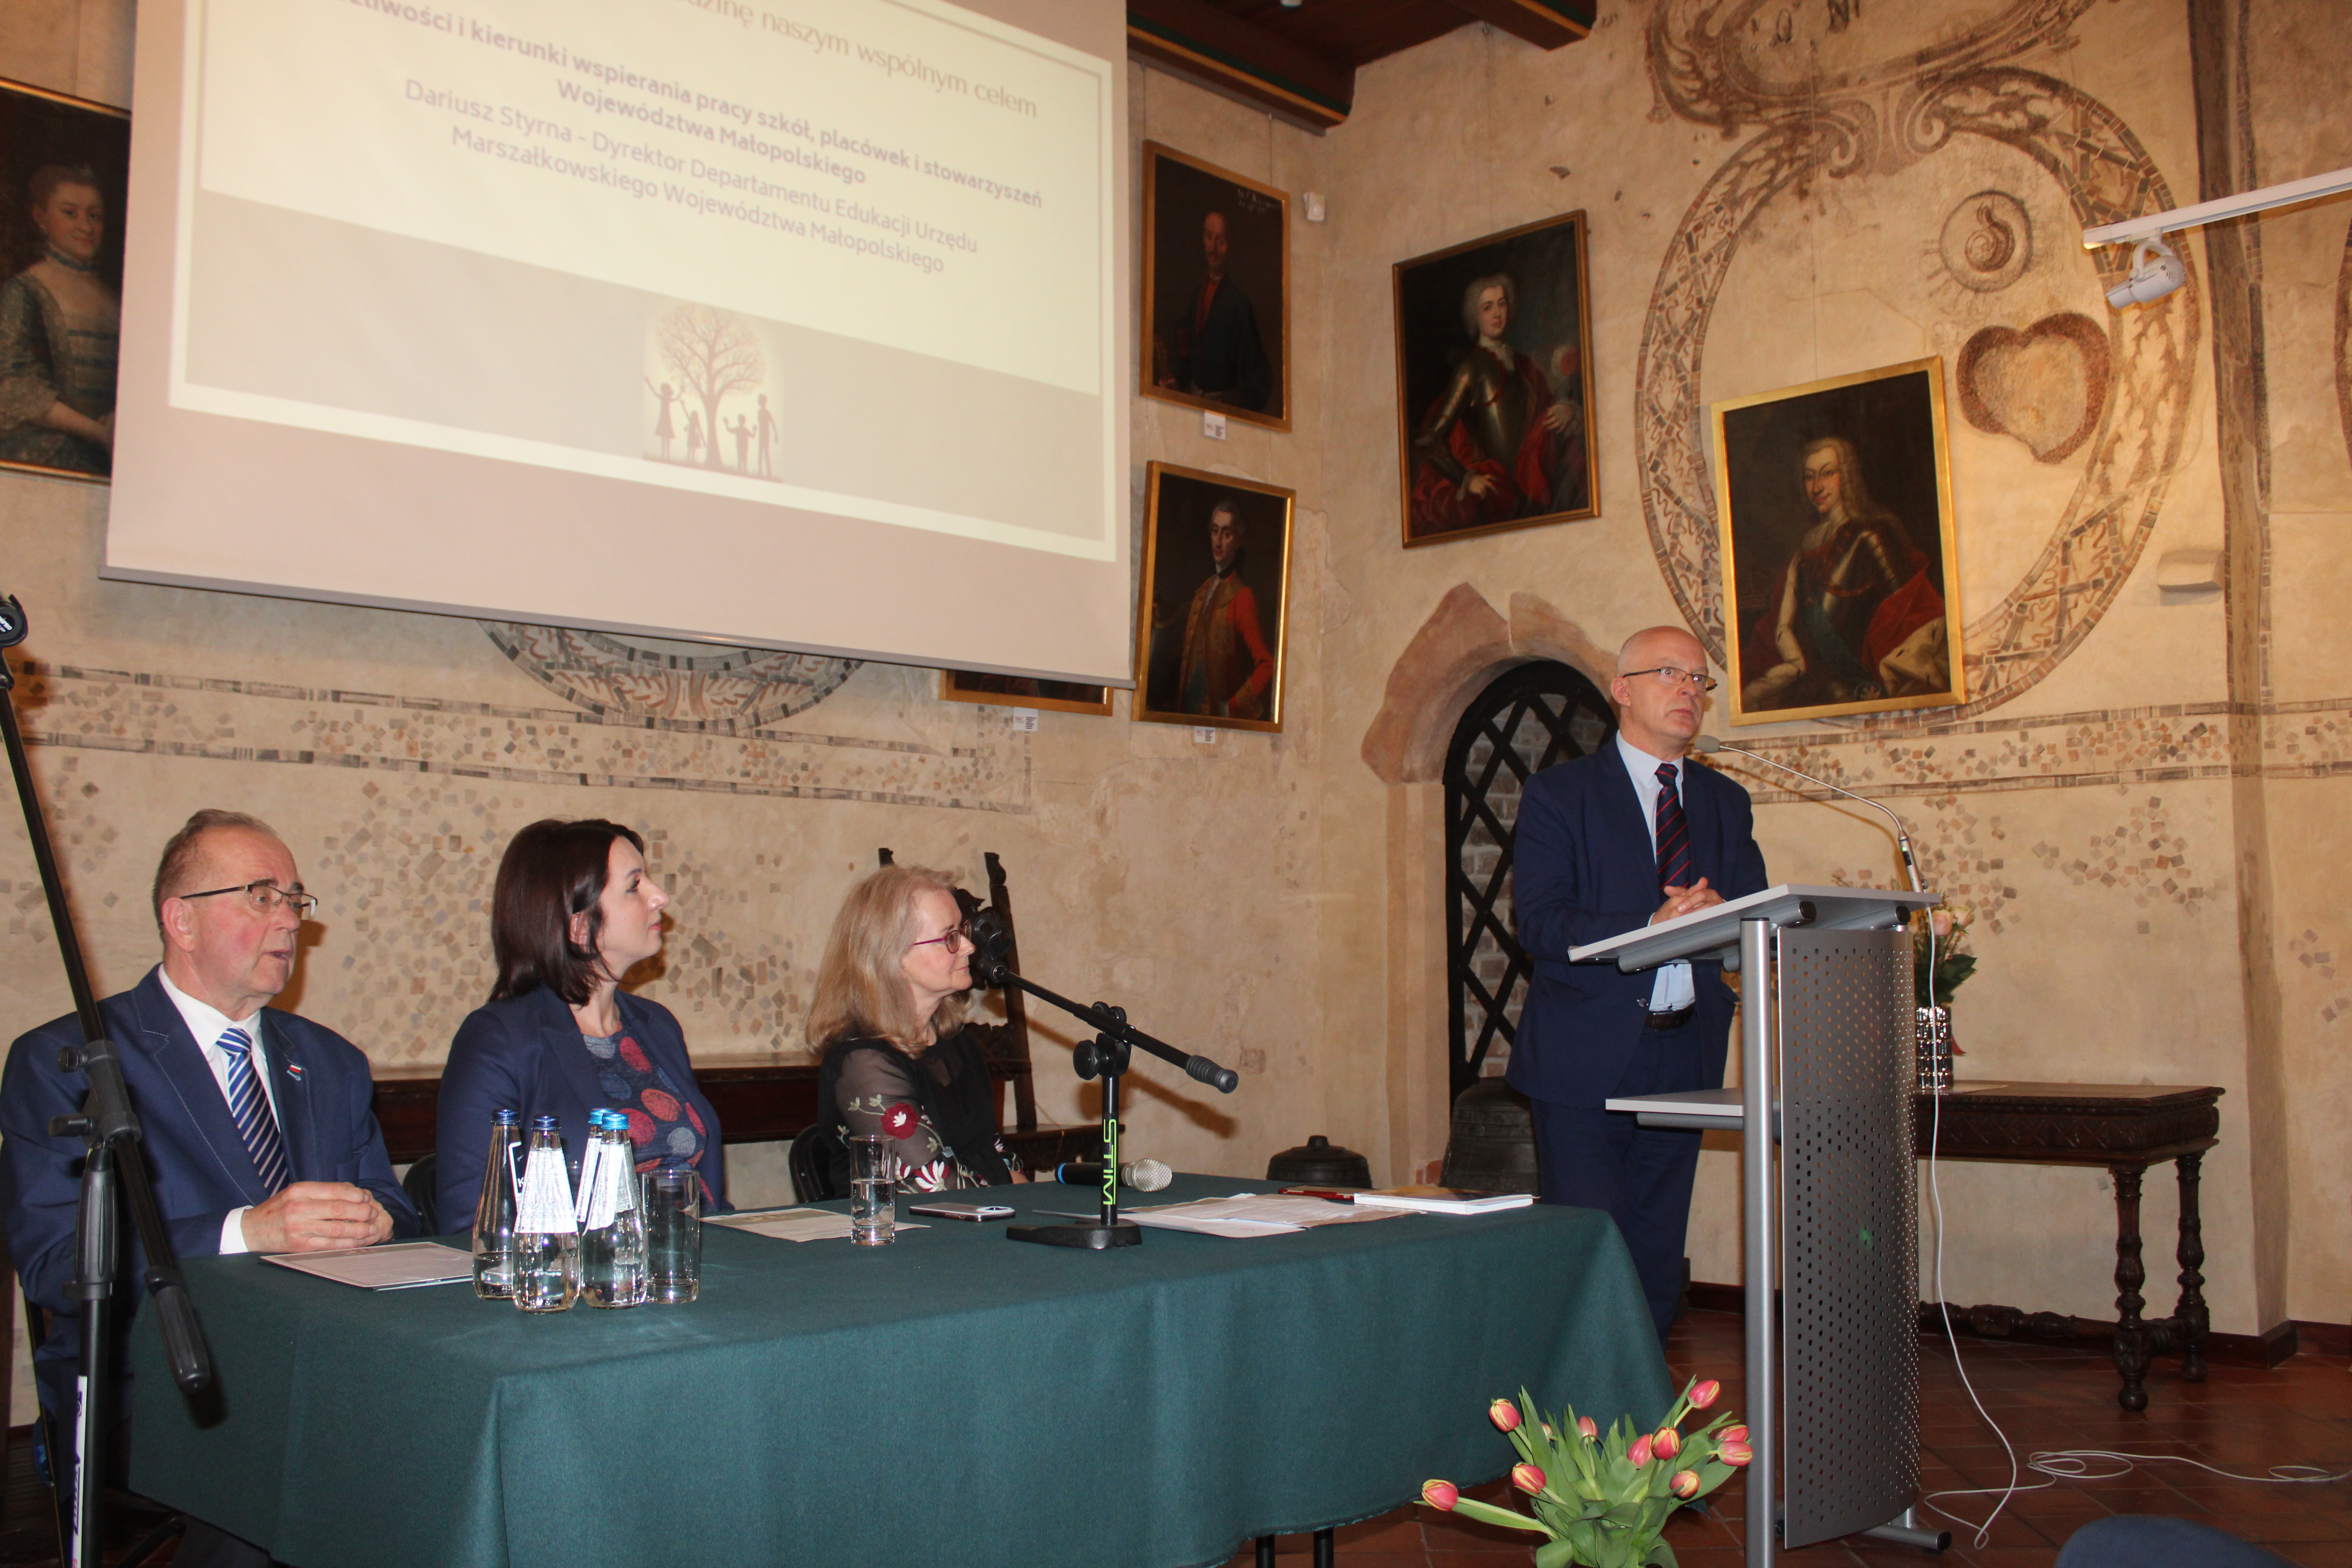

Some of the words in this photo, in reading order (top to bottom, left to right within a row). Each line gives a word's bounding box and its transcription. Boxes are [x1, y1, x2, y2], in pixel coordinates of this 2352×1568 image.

[458, 16, 465, 36] i
[471, 19, 567, 67] kierunki
[573, 55, 691, 104] wspierania
[697, 93, 752, 125] pracy
[757, 111, 815, 143] szkół,
[820, 129, 909, 169] placówek
[914, 153, 919, 171] i
[924, 160, 1042, 208] stowarzyszeń
[762, 12, 849, 55] naszym
[857, 43, 967, 95] wspólnym
[975, 84, 1037, 118] celem
[405, 78, 493, 122] Dariusz
[499, 106, 572, 142] Styrna
[593, 131, 686, 173] Dyrektor
[691, 158, 830, 213] Departamentu
[835, 198, 910, 238] Edukacji
[915, 220, 978, 253] Urzędu
[557, 79, 714, 141] Województwa
[720, 126, 866, 184] Małopolskiego
[452, 125, 658, 198] Marszałkowskiego
[663, 181, 806, 236] Województwa
[811, 220, 944, 273] Małopolskiego
[1103, 1119, 1117, 1205] STIM
